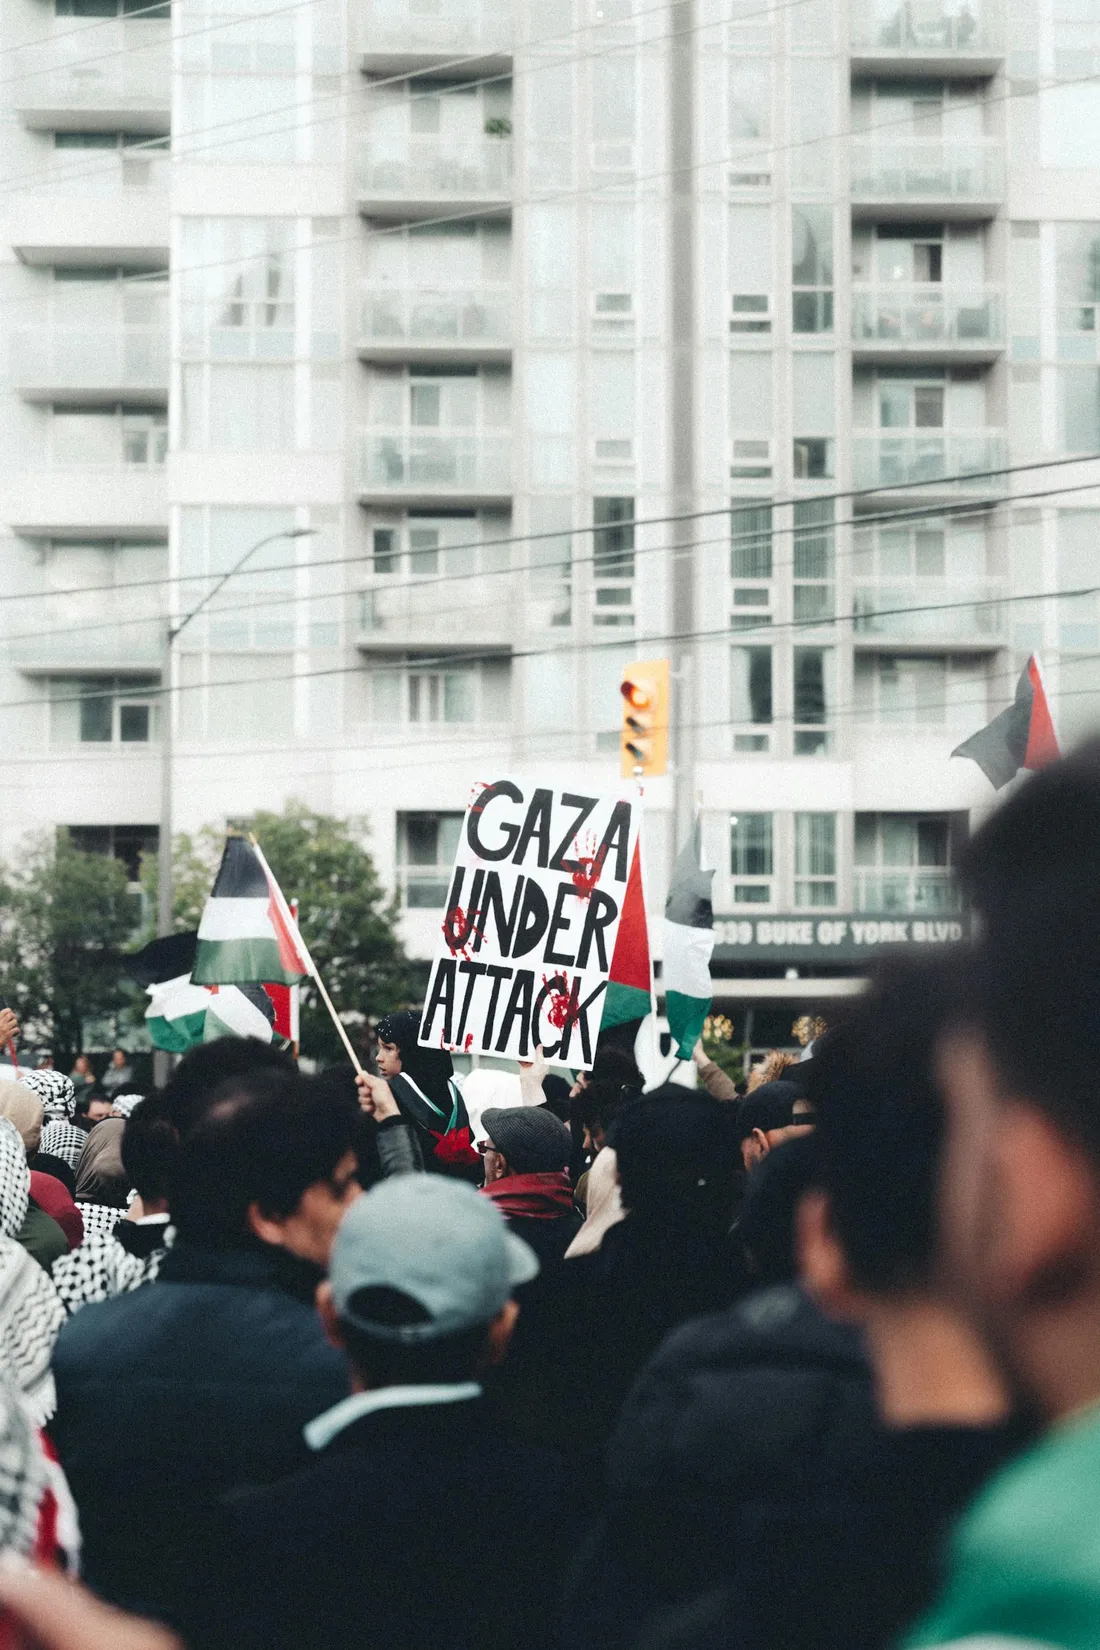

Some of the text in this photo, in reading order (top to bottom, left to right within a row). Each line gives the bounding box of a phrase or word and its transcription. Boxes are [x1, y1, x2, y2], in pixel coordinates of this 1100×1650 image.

[467, 780, 632, 882] GAZA
[443, 865, 619, 973] UNDER
[756, 921, 814, 945] DUKE
[817, 921, 849, 945] OF
[850, 921, 909, 944] YORK
[912, 921, 962, 942] BLVD
[420, 958, 608, 1065] ATTACK
